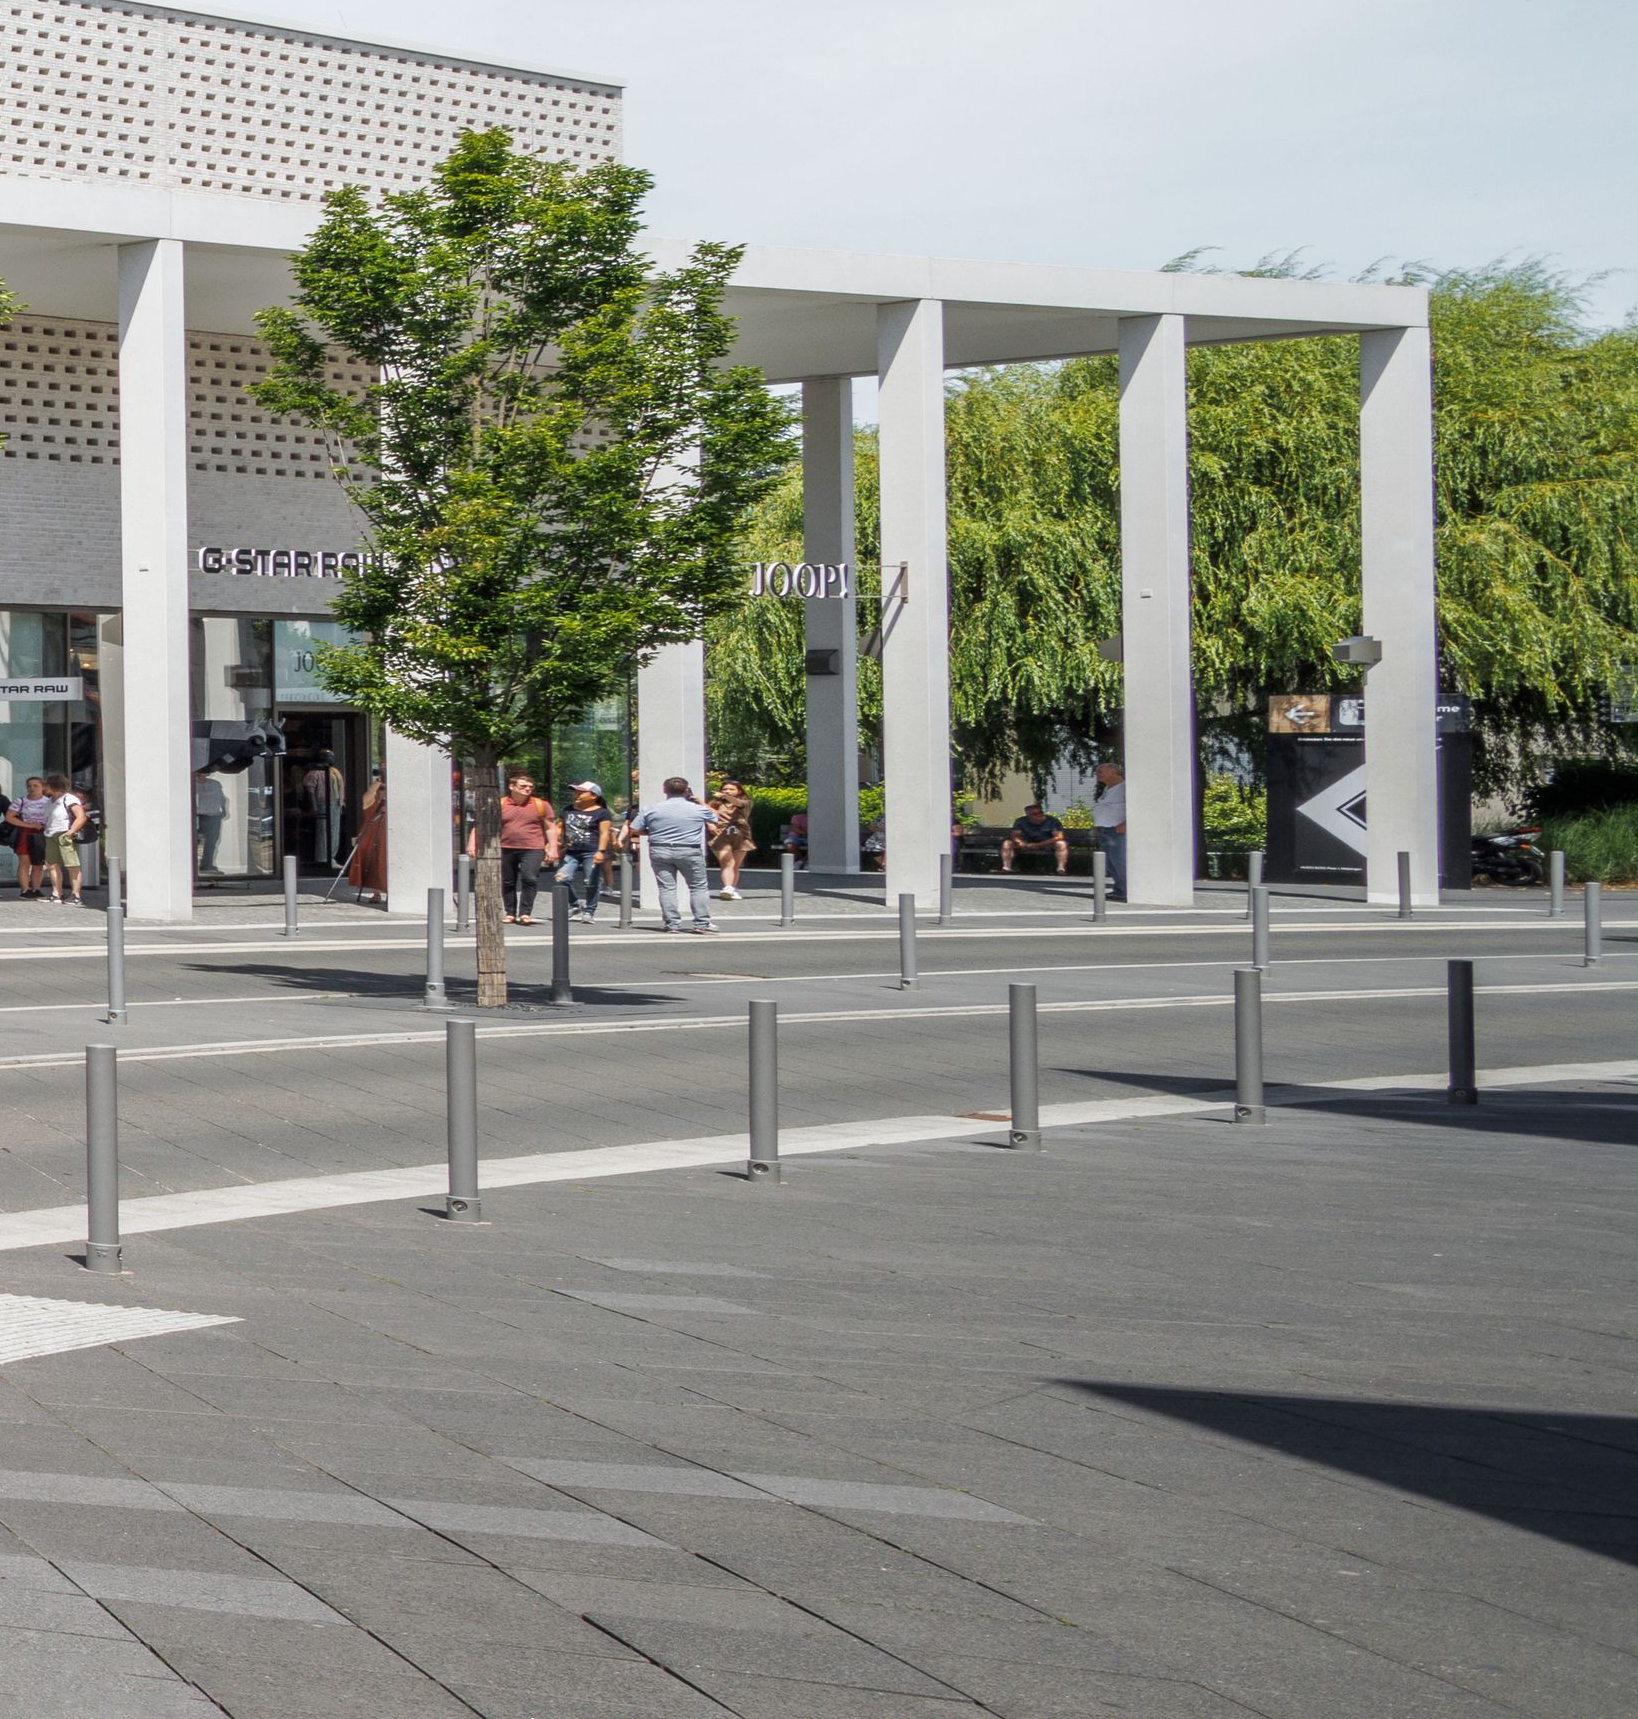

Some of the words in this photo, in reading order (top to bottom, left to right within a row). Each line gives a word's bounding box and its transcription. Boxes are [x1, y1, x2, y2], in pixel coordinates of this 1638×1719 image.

[199, 546, 312, 578] G-STAR
[748, 562, 848, 599] JOOP!
[33, 684, 69, 694] RAW
